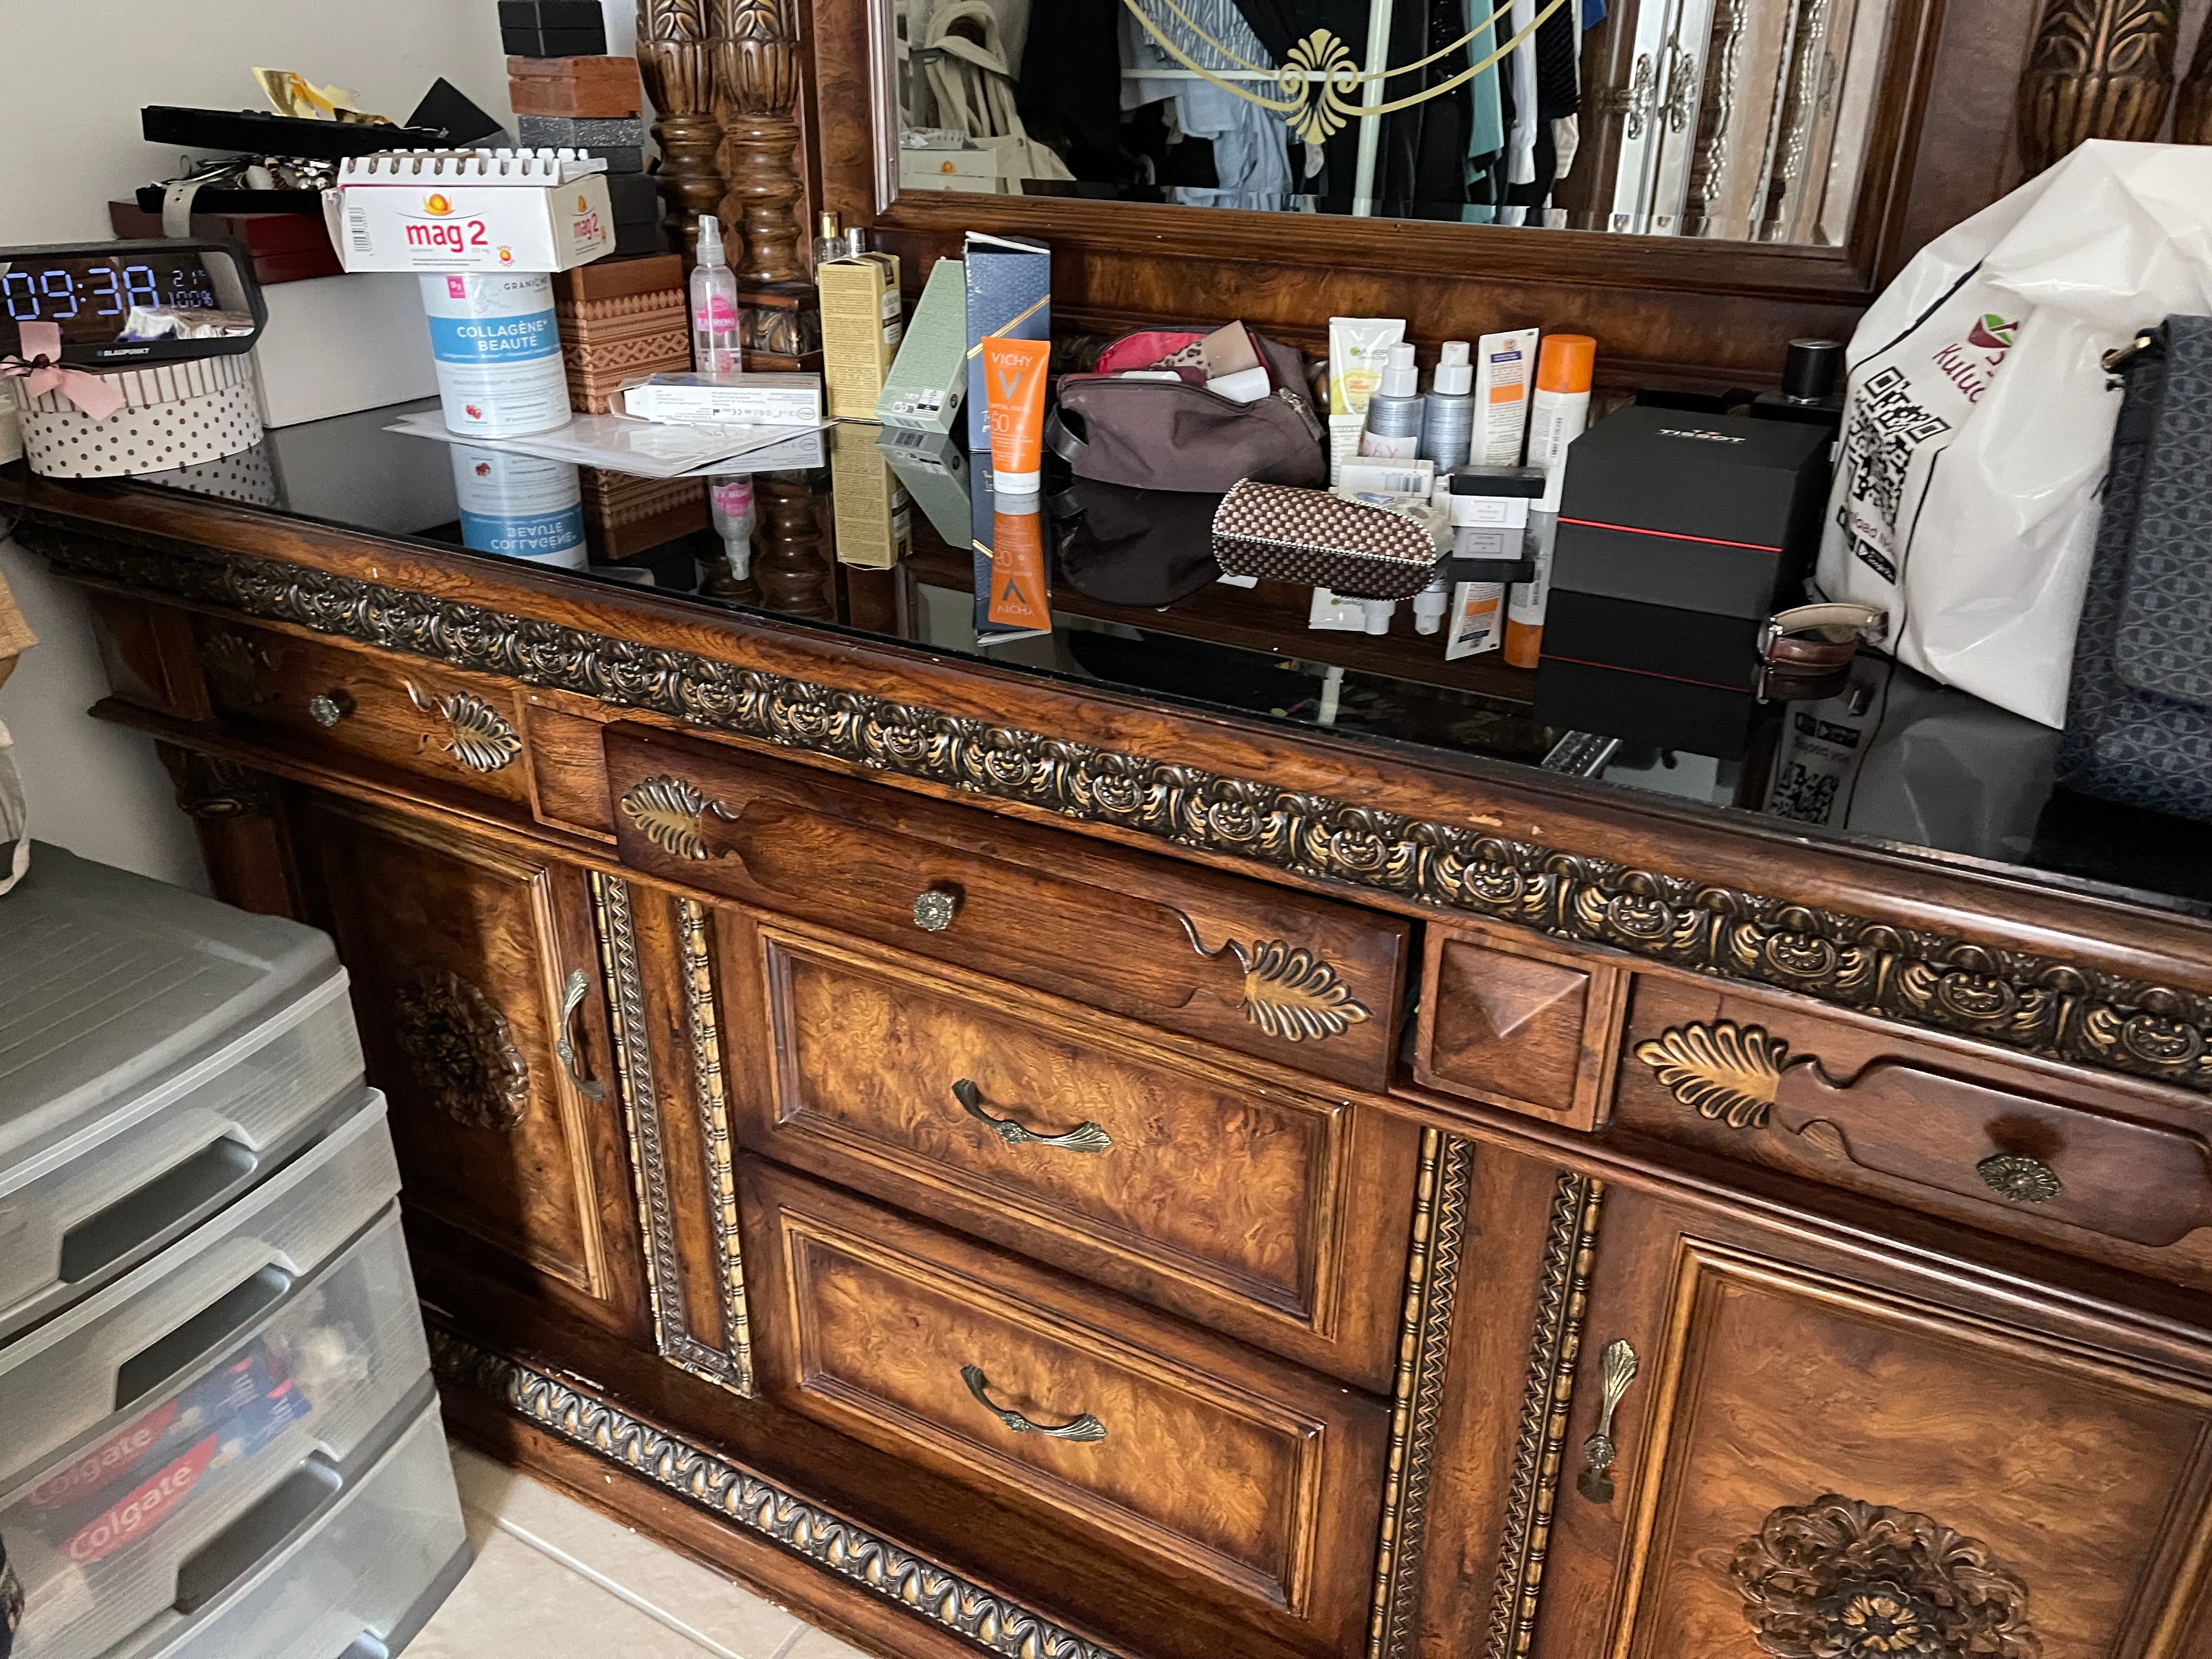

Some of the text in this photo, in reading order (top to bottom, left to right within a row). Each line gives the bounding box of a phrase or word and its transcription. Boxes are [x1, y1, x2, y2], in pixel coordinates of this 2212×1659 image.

[405, 220, 489, 253] mag 2
[2, 266, 160, 321] 09:38
[477, 334, 539, 352] BEAUTÉ
[991, 352, 1034, 367] VICHY
[70, 1466, 193, 1559] Colgate
